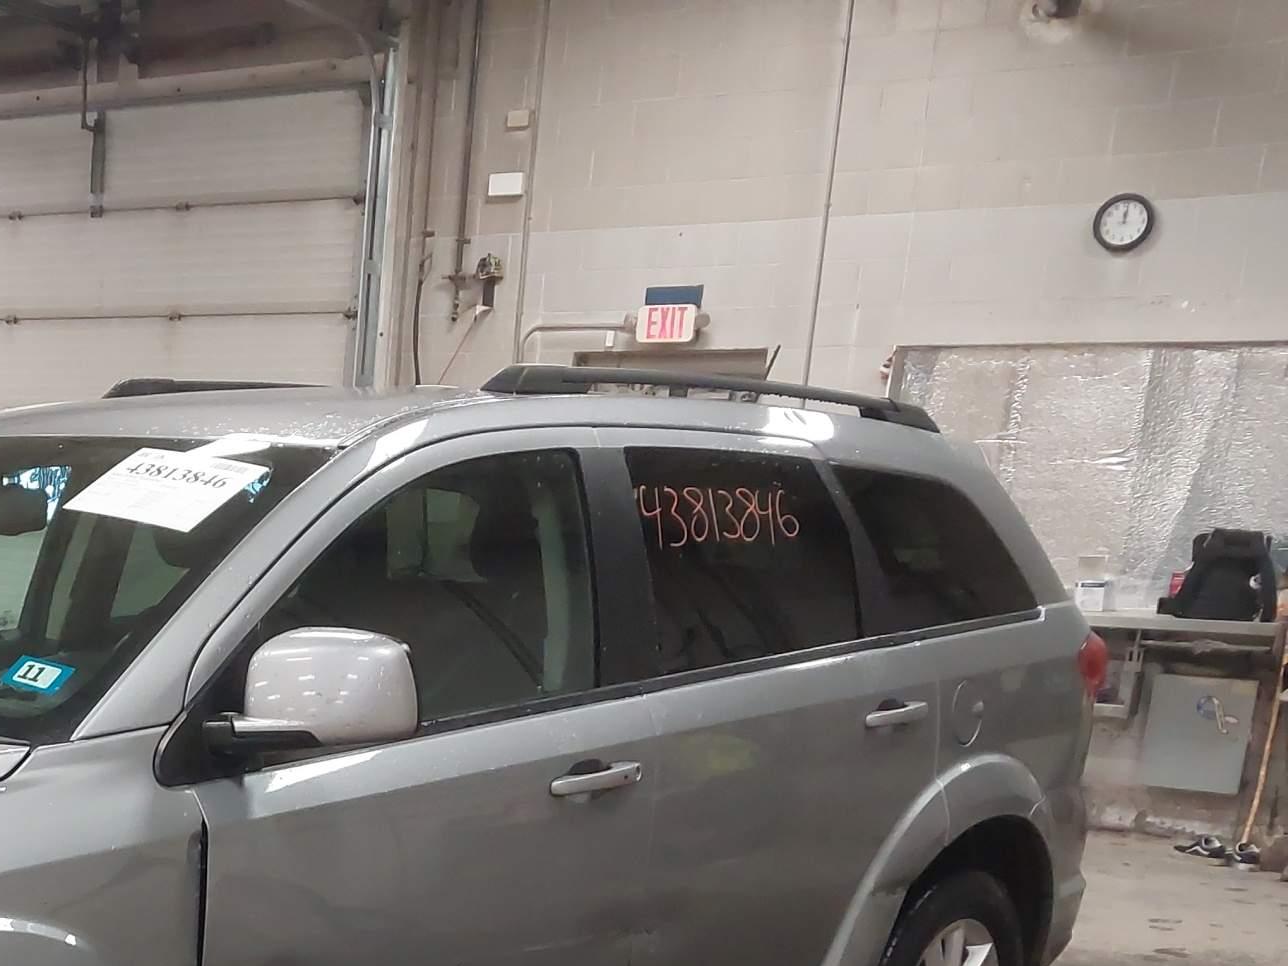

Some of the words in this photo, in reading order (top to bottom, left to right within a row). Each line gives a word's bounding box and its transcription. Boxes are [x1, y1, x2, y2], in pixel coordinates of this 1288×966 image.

[646, 306, 689, 339] EXIT
[126, 462, 229, 488] 43813846
[639, 484, 800, 549] 43813846
[17, 664, 46, 683] 11
